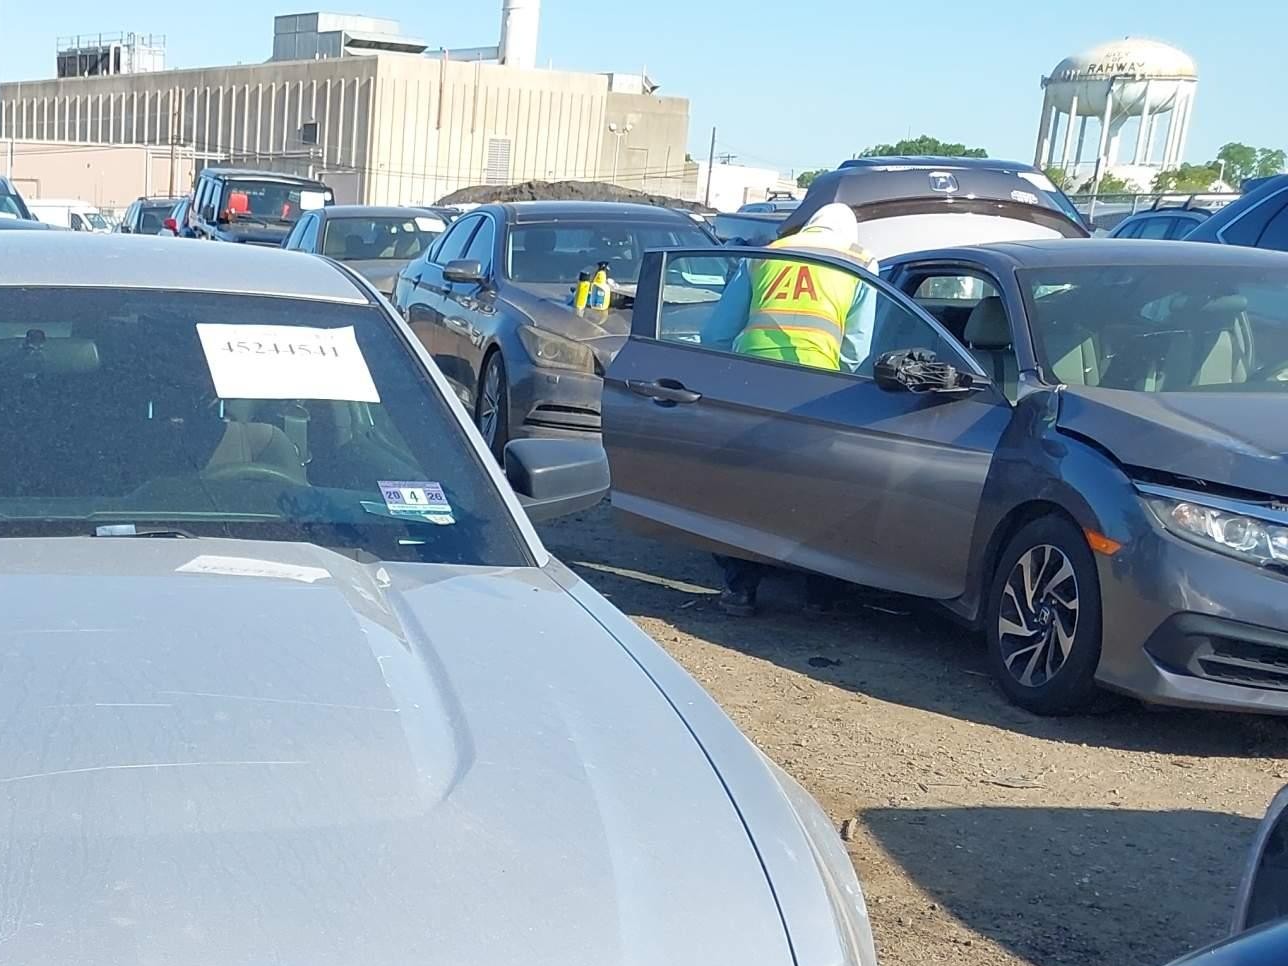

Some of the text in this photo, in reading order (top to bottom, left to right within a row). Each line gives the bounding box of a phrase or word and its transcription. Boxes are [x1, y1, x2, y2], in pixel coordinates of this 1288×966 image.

[385, 491, 443, 502] 20 4 26
